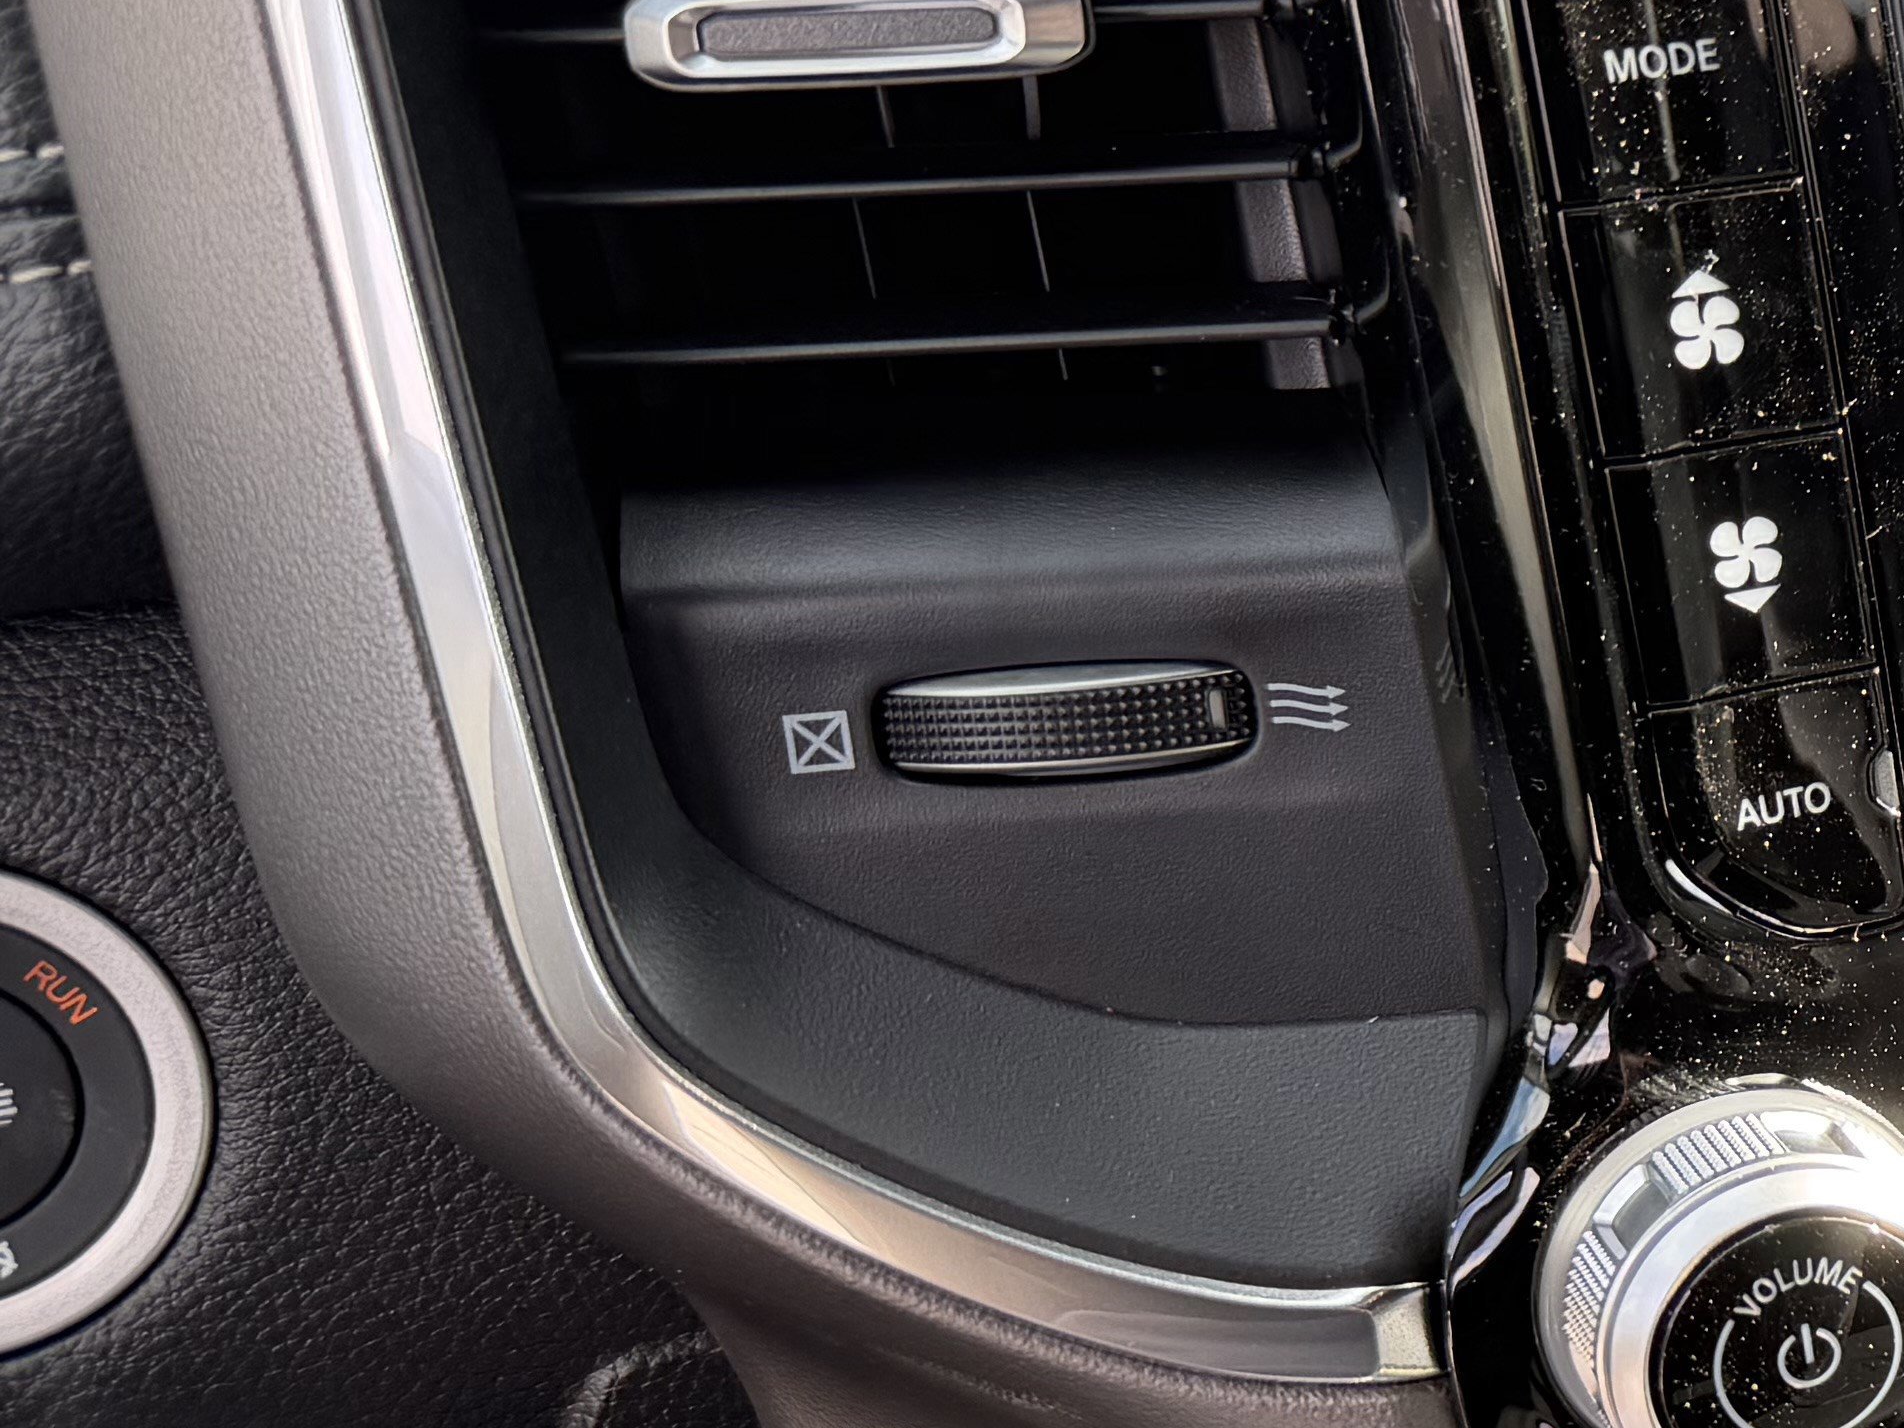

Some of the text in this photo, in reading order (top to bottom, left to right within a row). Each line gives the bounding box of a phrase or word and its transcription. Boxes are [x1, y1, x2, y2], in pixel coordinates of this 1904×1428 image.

[1604, 39, 1720, 84] MODE
[1737, 781, 1831, 830] AUTO
[23, 960, 97, 1025] RUN
[1733, 1256, 1863, 1319] VOLUME
